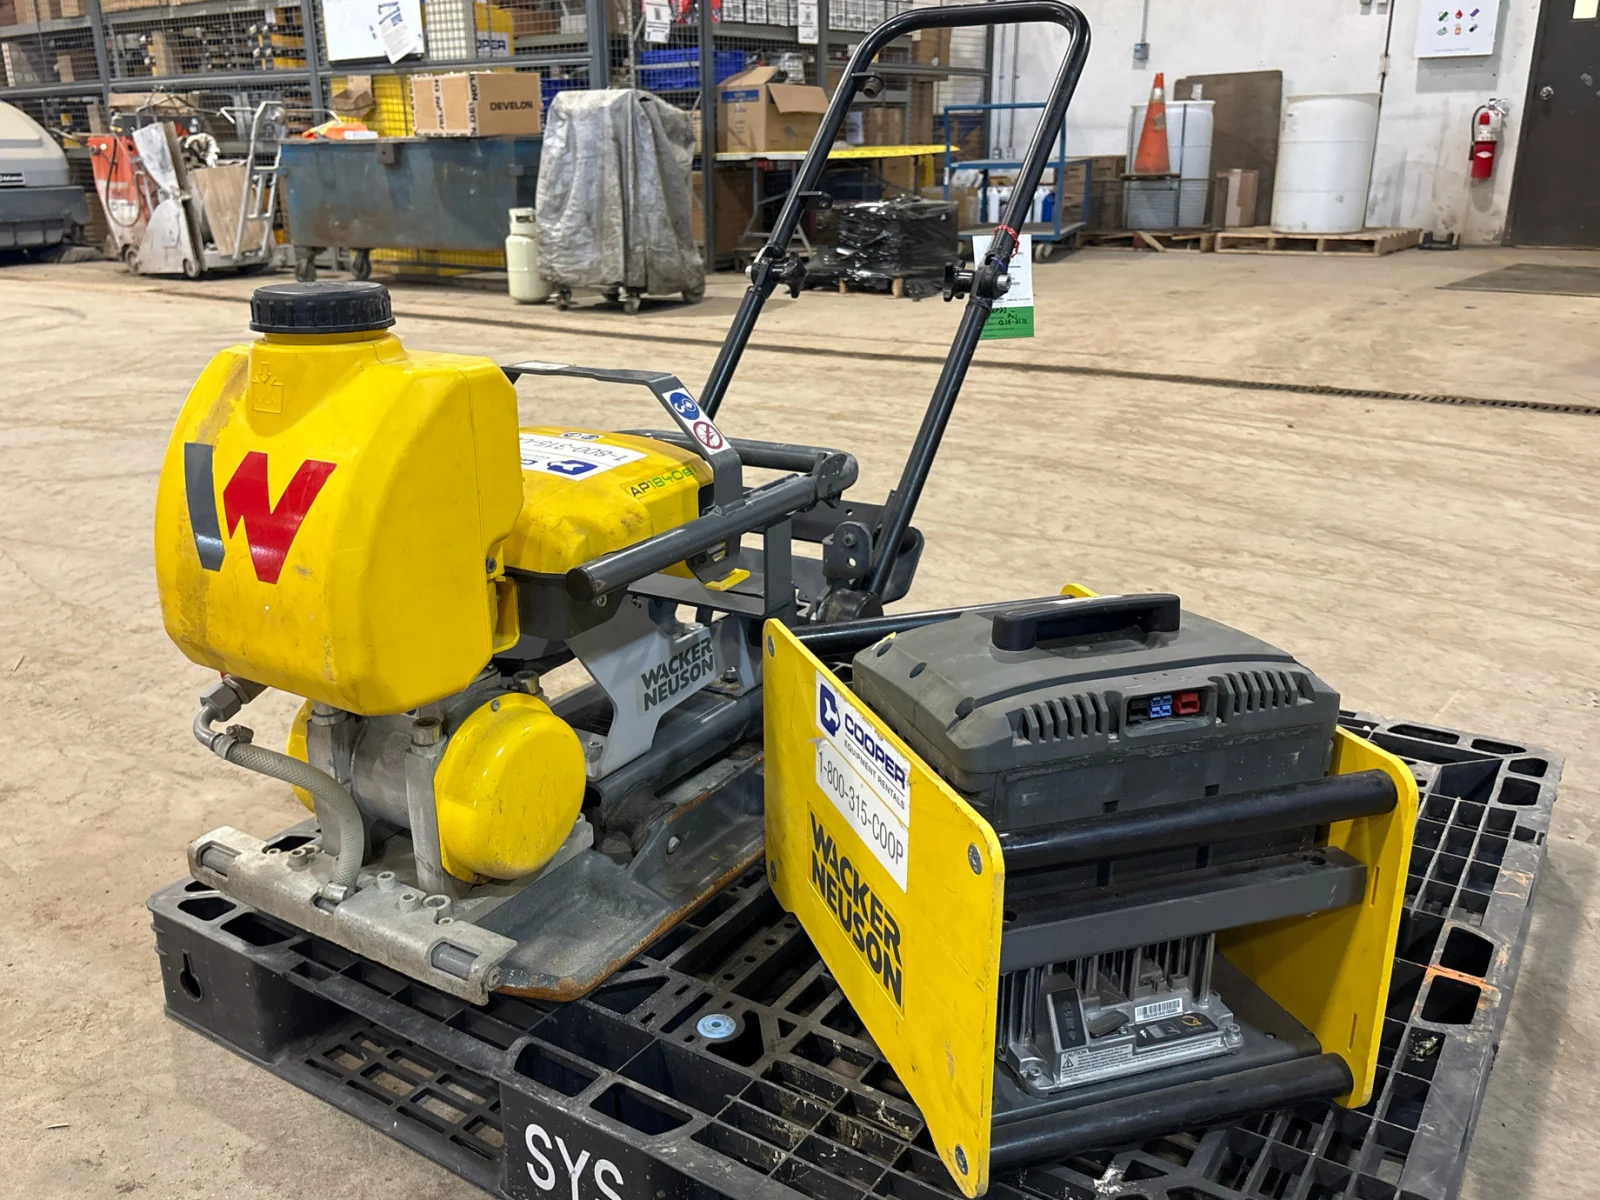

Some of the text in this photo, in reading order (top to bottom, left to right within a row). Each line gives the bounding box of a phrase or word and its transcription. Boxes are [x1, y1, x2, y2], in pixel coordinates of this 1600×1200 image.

[490, 101, 533, 111] DEVELON
[641, 637, 713, 690] WACKER
[643, 654, 714, 712] NEUSON
[844, 740, 905, 810] EQUIPMENT RENTALS
[845, 713, 905, 790] COOPER
[818, 750, 904, 865] 1-800-315-COOP
[810, 812, 902, 968] WACKER
[812, 849, 902, 1007] NEUSON
[525, 1123, 624, 1200] SYS
